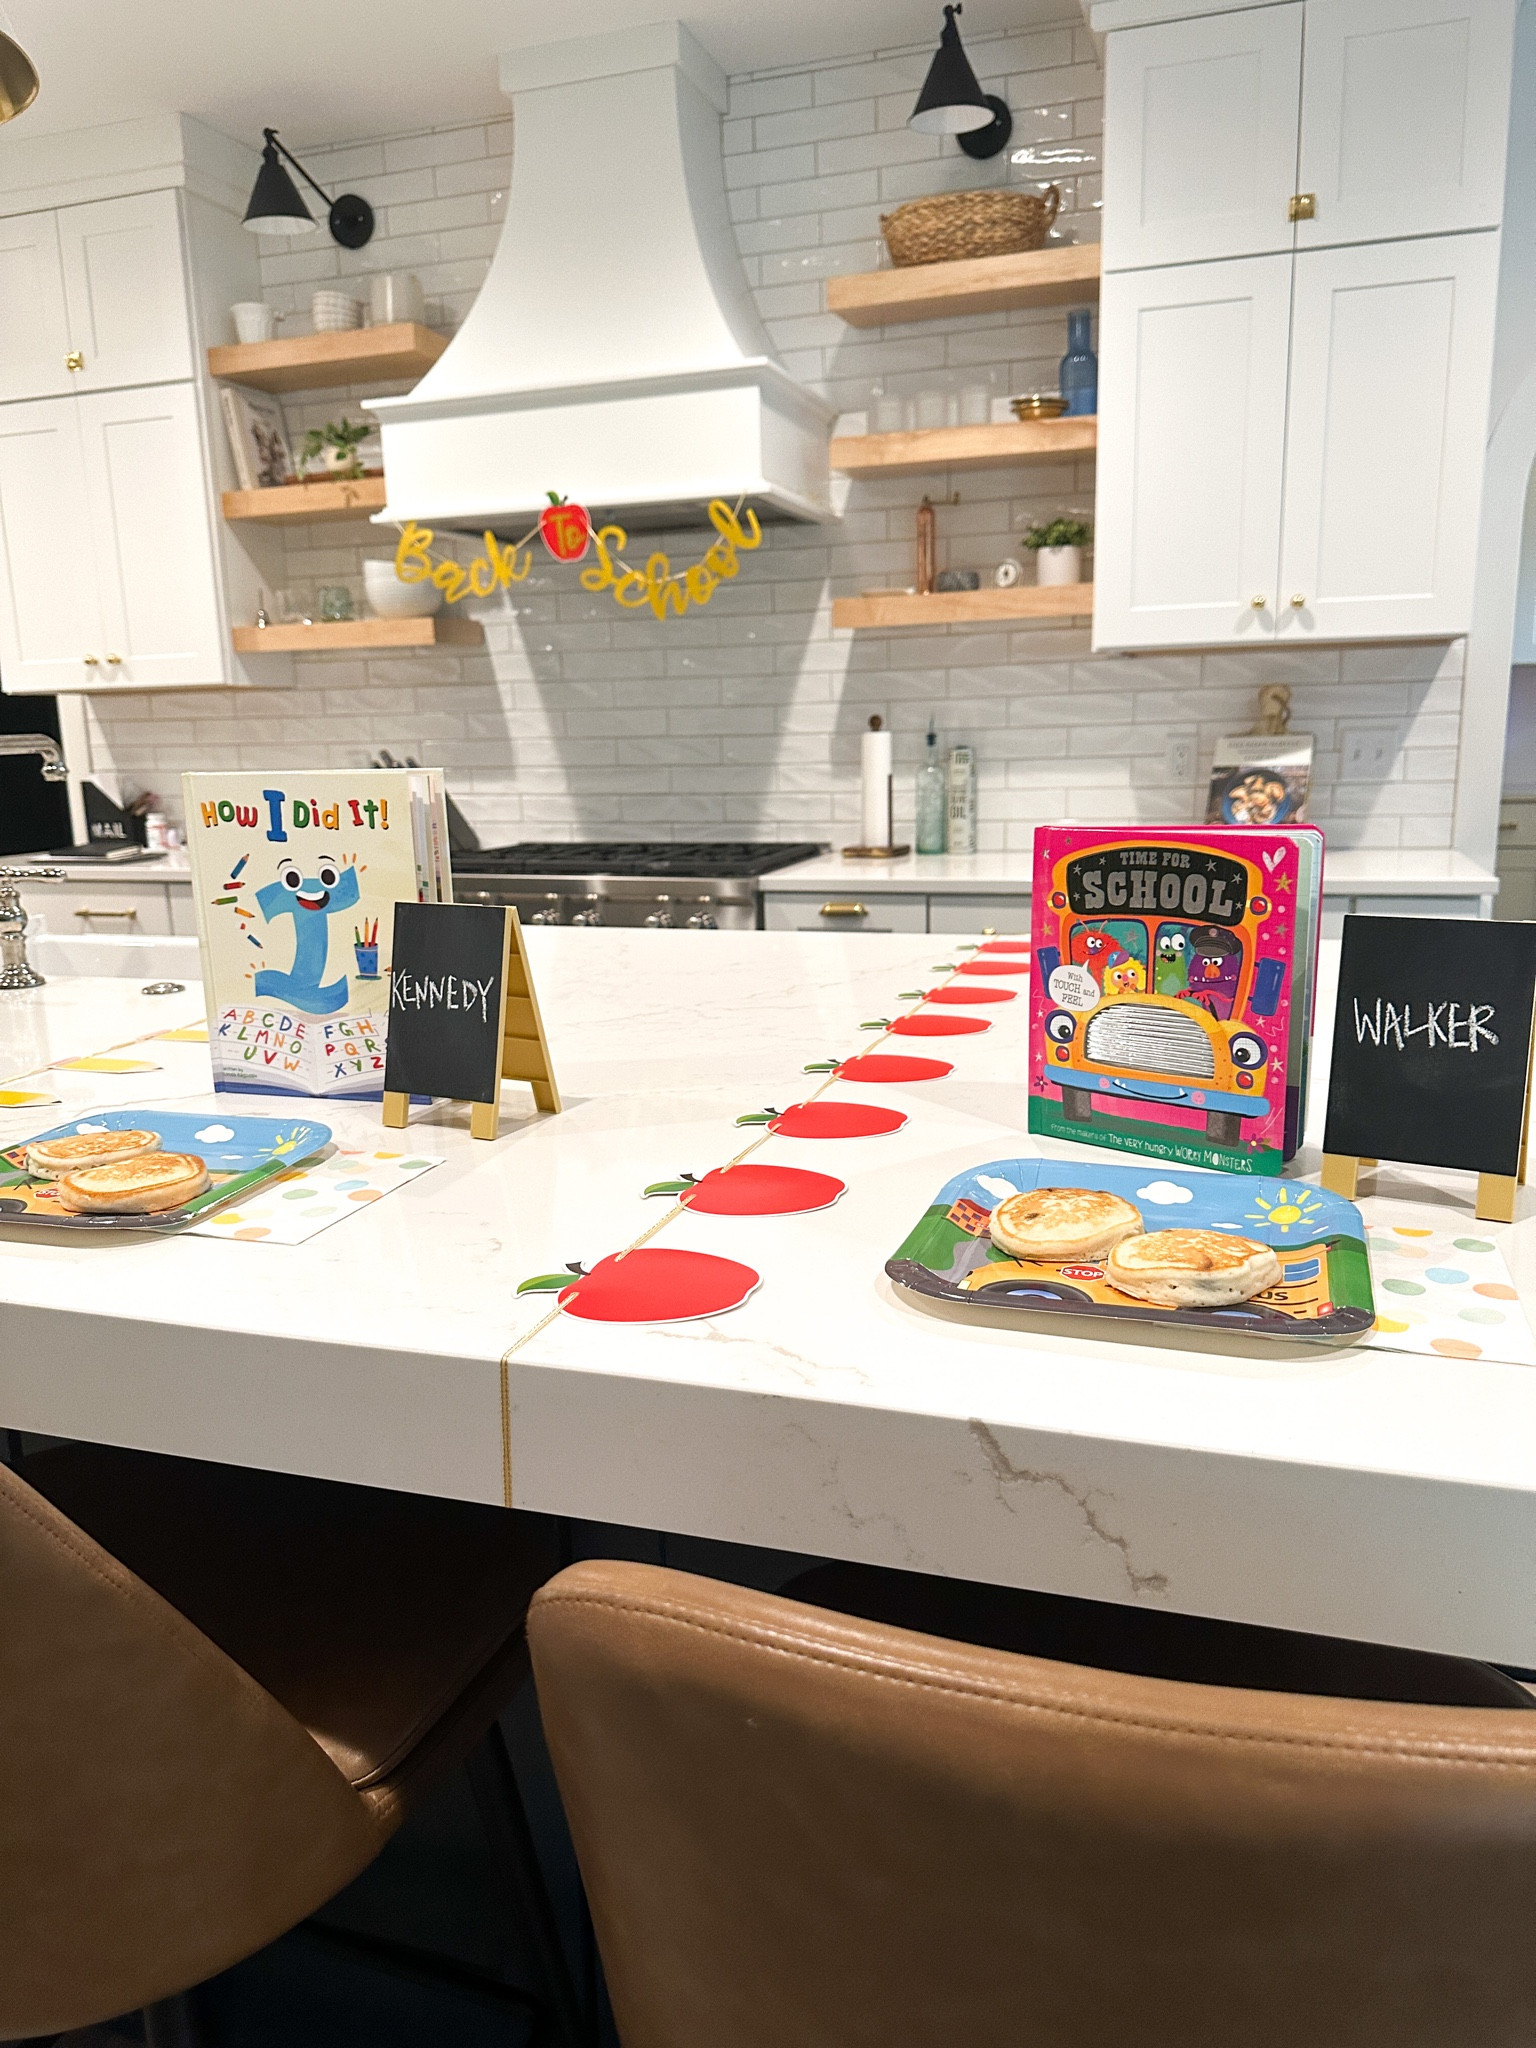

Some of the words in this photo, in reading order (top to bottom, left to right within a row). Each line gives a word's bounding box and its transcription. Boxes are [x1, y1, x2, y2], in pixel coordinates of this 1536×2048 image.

[395, 520, 532, 603] Back
[549, 513, 586, 558] To
[580, 499, 762, 621] School
[262, 789, 288, 842] I
[293, 798, 340, 831] Did
[347, 798, 390, 830] It!
[1120, 851, 1158, 866] TIME
[1162, 852, 1191, 869] FOR
[1082, 870, 1233, 917] SCHOOL
[1053, 978, 1081, 994] TOUCH
[1083, 988, 1095, 998] and
[1067, 972, 1083, 983] With
[392, 968, 494, 1023] KENNEDY
[1062, 993, 1084, 1007] FEEL
[1353, 997, 1500, 1052] WALKER
[1108, 1133, 1122, 1145] The
[1124, 1137, 1143, 1149] VERY
[1145, 1142, 1174, 1157] hungry
[1203, 1150, 1253, 1173] MONSTERS
[1062, 1268, 1104, 1278] STOP
[1256, 1291, 1288, 1301] US
